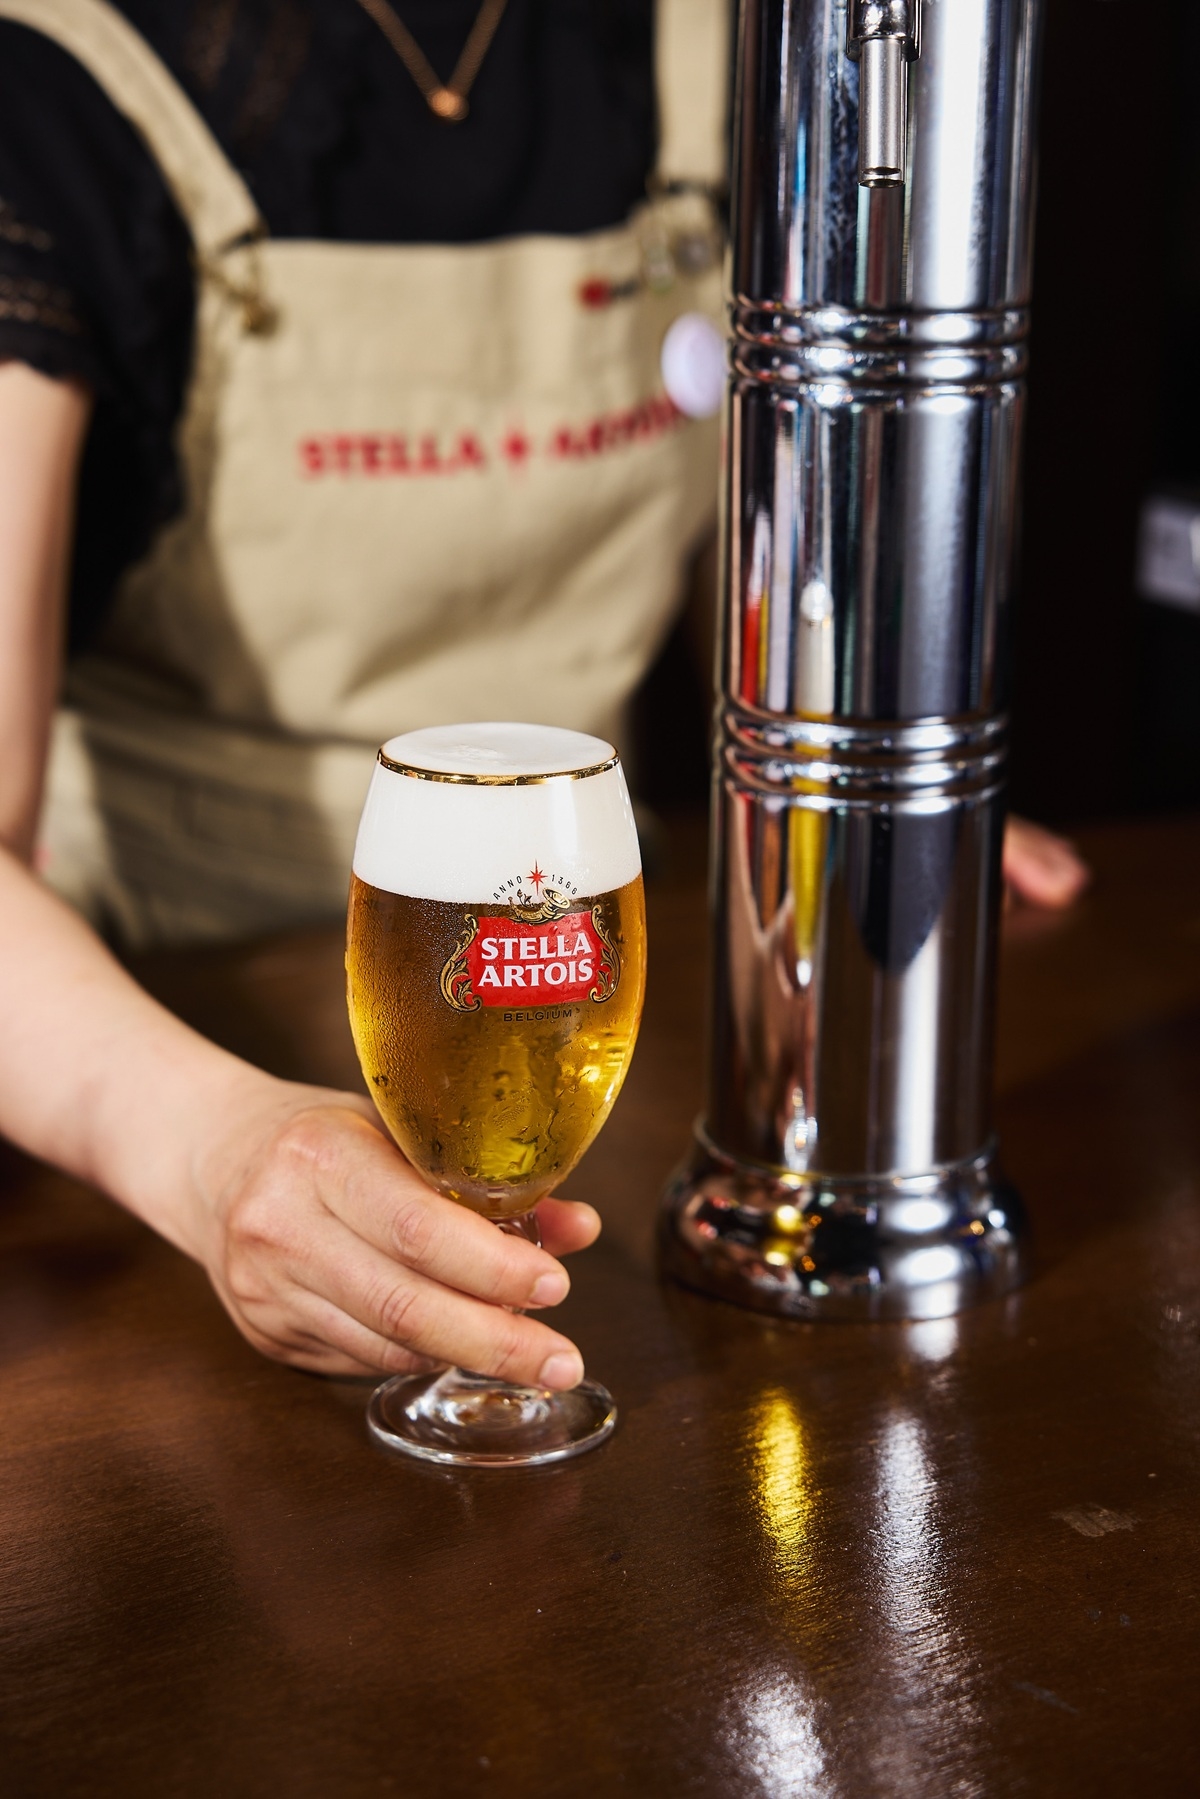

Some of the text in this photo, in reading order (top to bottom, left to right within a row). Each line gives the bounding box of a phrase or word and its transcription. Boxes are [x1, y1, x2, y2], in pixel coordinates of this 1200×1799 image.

[299, 431, 487, 480] STELLA
[492, 873, 578, 900] ANNO 1366
[481, 932, 593, 960] STELLA
[477, 958, 594, 988] ARTOIS
[503, 1009, 573, 1022] BELGIUM
